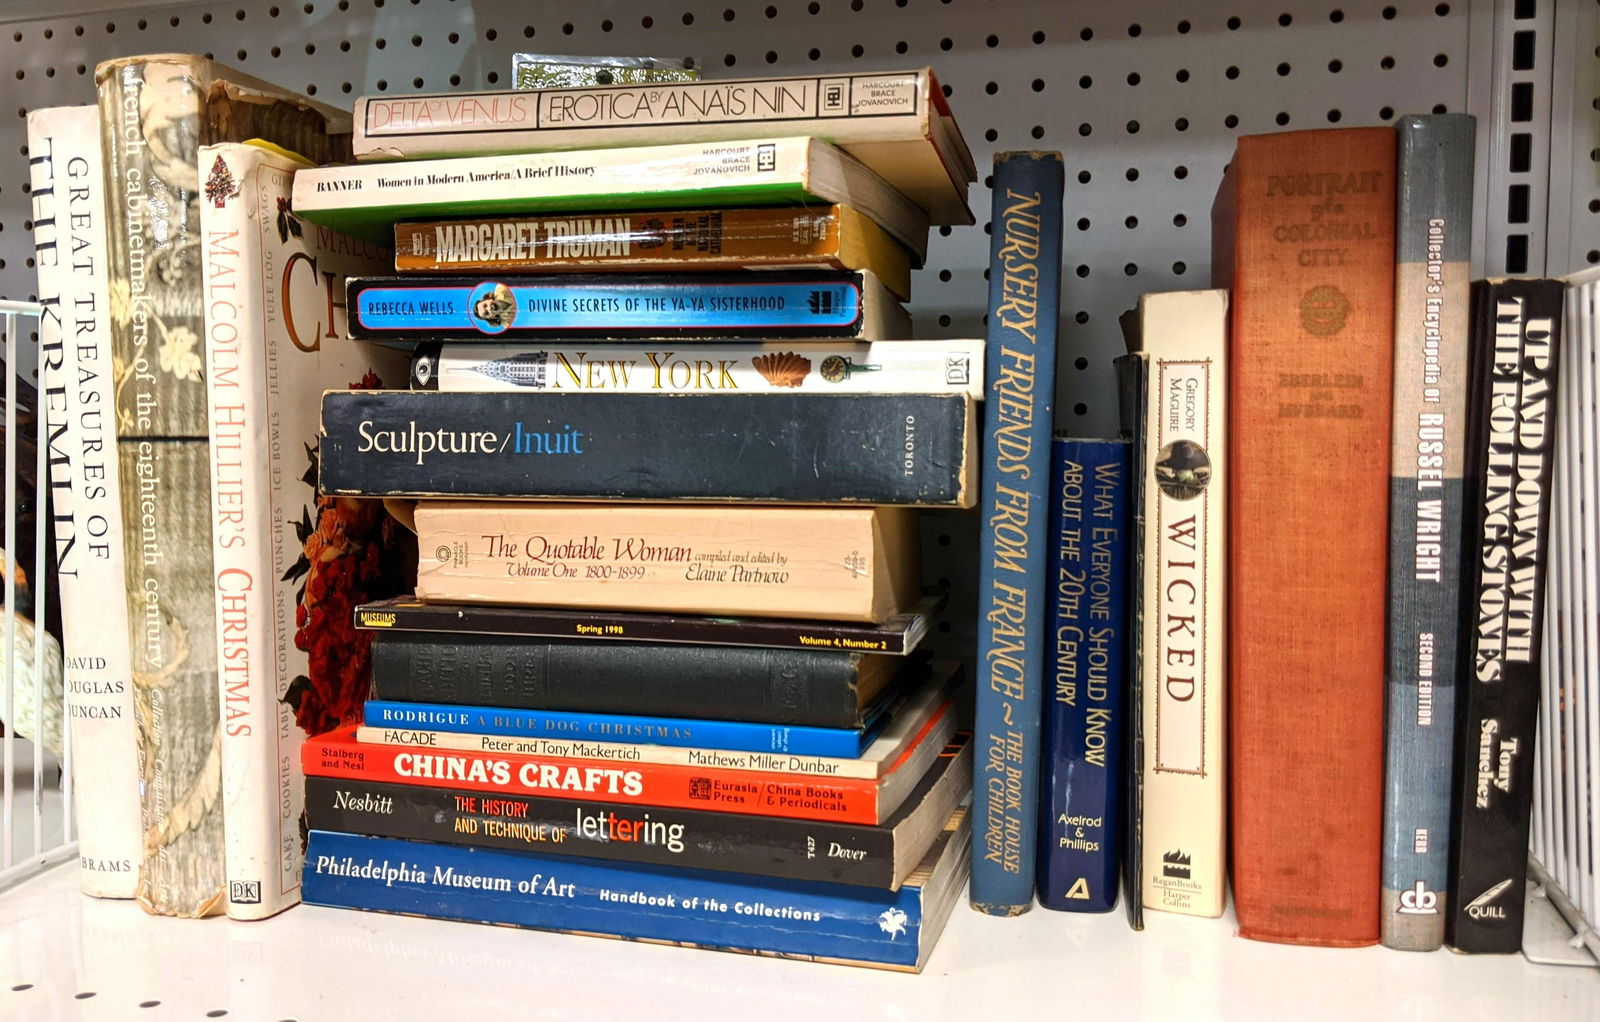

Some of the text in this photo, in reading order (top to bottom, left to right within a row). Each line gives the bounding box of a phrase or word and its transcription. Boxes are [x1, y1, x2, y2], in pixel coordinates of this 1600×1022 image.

[862, 80, 904, 89] HARCOURT
[871, 89, 896, 98] BRACE
[373, 96, 528, 128] DELTA VENUS
[549, 91, 652, 122] EROTICA
[661, 85, 746, 118] ANAÏS
[752, 85, 806, 115] NIN
[858, 97, 909, 108] JOVANOVICH
[316, 179, 363, 193] BANNER
[377, 177, 412, 189] Women
[426, 173, 465, 186] Modern
[524, 166, 553, 179] Brief
[554, 165, 598, 179] History
[1267, 171, 1382, 197] PORTRAIT
[29, 137, 58, 267] THE
[435, 222, 538, 263] MARGARET
[544, 217, 632, 259] TRUMAN
[1273, 222, 1376, 243] COLONIAL
[126, 167, 154, 347] cabinetmakers
[1298, 248, 1349, 267] CITY
[368, 301, 454, 315] REBECCA WELLS
[528, 296, 785, 313] DIVINE SECRETS OF THE YA-YA SISTERHOOD
[67, 156, 110, 560] GREAT TREASURES OF
[135, 358, 156, 384] of
[645, 352, 739, 389] YORK
[136, 392, 158, 430] the
[1169, 377, 1181, 432] MAGUIRE
[1185, 377, 1198, 432] GREGORY
[1414, 218, 1445, 583] Collector's Encyclopedia RUSSEL WRIGHT
[904, 415, 915, 476] TORONTO
[985, 188, 1041, 702] NURSERY FRIENDS FROM FRANCE
[208, 230, 254, 738] MALCOLM HILLIER'S CHRISTMAS
[1092, 462, 1120, 521] WHAT
[1475, 296, 1523, 683] THE ROLLING STONES
[1506, 317, 1552, 662] UP AND DOWN WITH
[136, 441, 165, 566] eighteenth
[260, 184, 294, 872] CAKE COOKIES DECORATIONS PUNCHES ICE BOWLS JELLIES YULE LOG SWAGS
[481, 534, 517, 559] The
[525, 535, 605, 566] Quotable
[612, 537, 692, 563] Woman
[694, 550, 730, 565] compiled
[731, 551, 750, 563] and
[750, 550, 774, 564] edited
[775, 552, 788, 567] by
[505, 562, 646, 580] Volume One 1800-1899
[685, 563, 790, 585] Elaine Partnow
[1055, 459, 1086, 708] ABOUT THE 20TH CENTURY
[360, 612, 396, 624] MUSEUMS
[1166, 513, 1197, 702] WICKED
[144, 577, 163, 669] century
[576, 624, 624, 635] Spring 1998
[799, 635, 880, 649] Volume Number
[1417, 632, 1434, 726] SECOND EDITION
[383, 709, 692, 738] RODRIGUE A BLUE DOG CHRISTMAS
[384, 730, 437, 745] FACADE
[1084, 708, 1112, 768] KNOW
[321, 747, 365, 762] Stalberg
[481, 736, 641, 760] Peter and Tony Mackertich
[688, 751, 840, 774] Mathews Miller Dunbar
[393, 752, 643, 797] CHINA'S CRAFTS
[1476, 718, 1498, 809] Sanchez
[1494, 737, 1518, 793] Tony
[713, 780, 758, 794] Eurasia
[713, 791, 746, 804] Press
[766, 783, 844, 800] China Books
[984, 733, 1005, 865] FOR CHILDREN
[333, 790, 393, 814] Nesbitt
[454, 795, 529, 818] THE HISTORY
[779, 796, 847, 812] Periodicals
[1003, 731, 1023, 875] THE BOOK HOUSE
[454, 817, 567, 844] AND TECHNIQUE OF
[576, 807, 685, 853] lettering
[1058, 813, 1102, 828] Axelrod
[827, 842, 867, 861] Dover
[1059, 836, 1100, 853] Phillips
[316, 855, 426, 888] Philadelphia
[432, 866, 512, 893] Museum
[518, 874, 542, 894] of
[542, 876, 576, 898] Art
[1152, 875, 1202, 890] ReganBooks
[599, 889, 821, 922] Handbook of the Collections
[1162, 888, 1191, 901] Harper
[1162, 897, 1192, 909] Collins
[1468, 905, 1506, 919] QUILL
